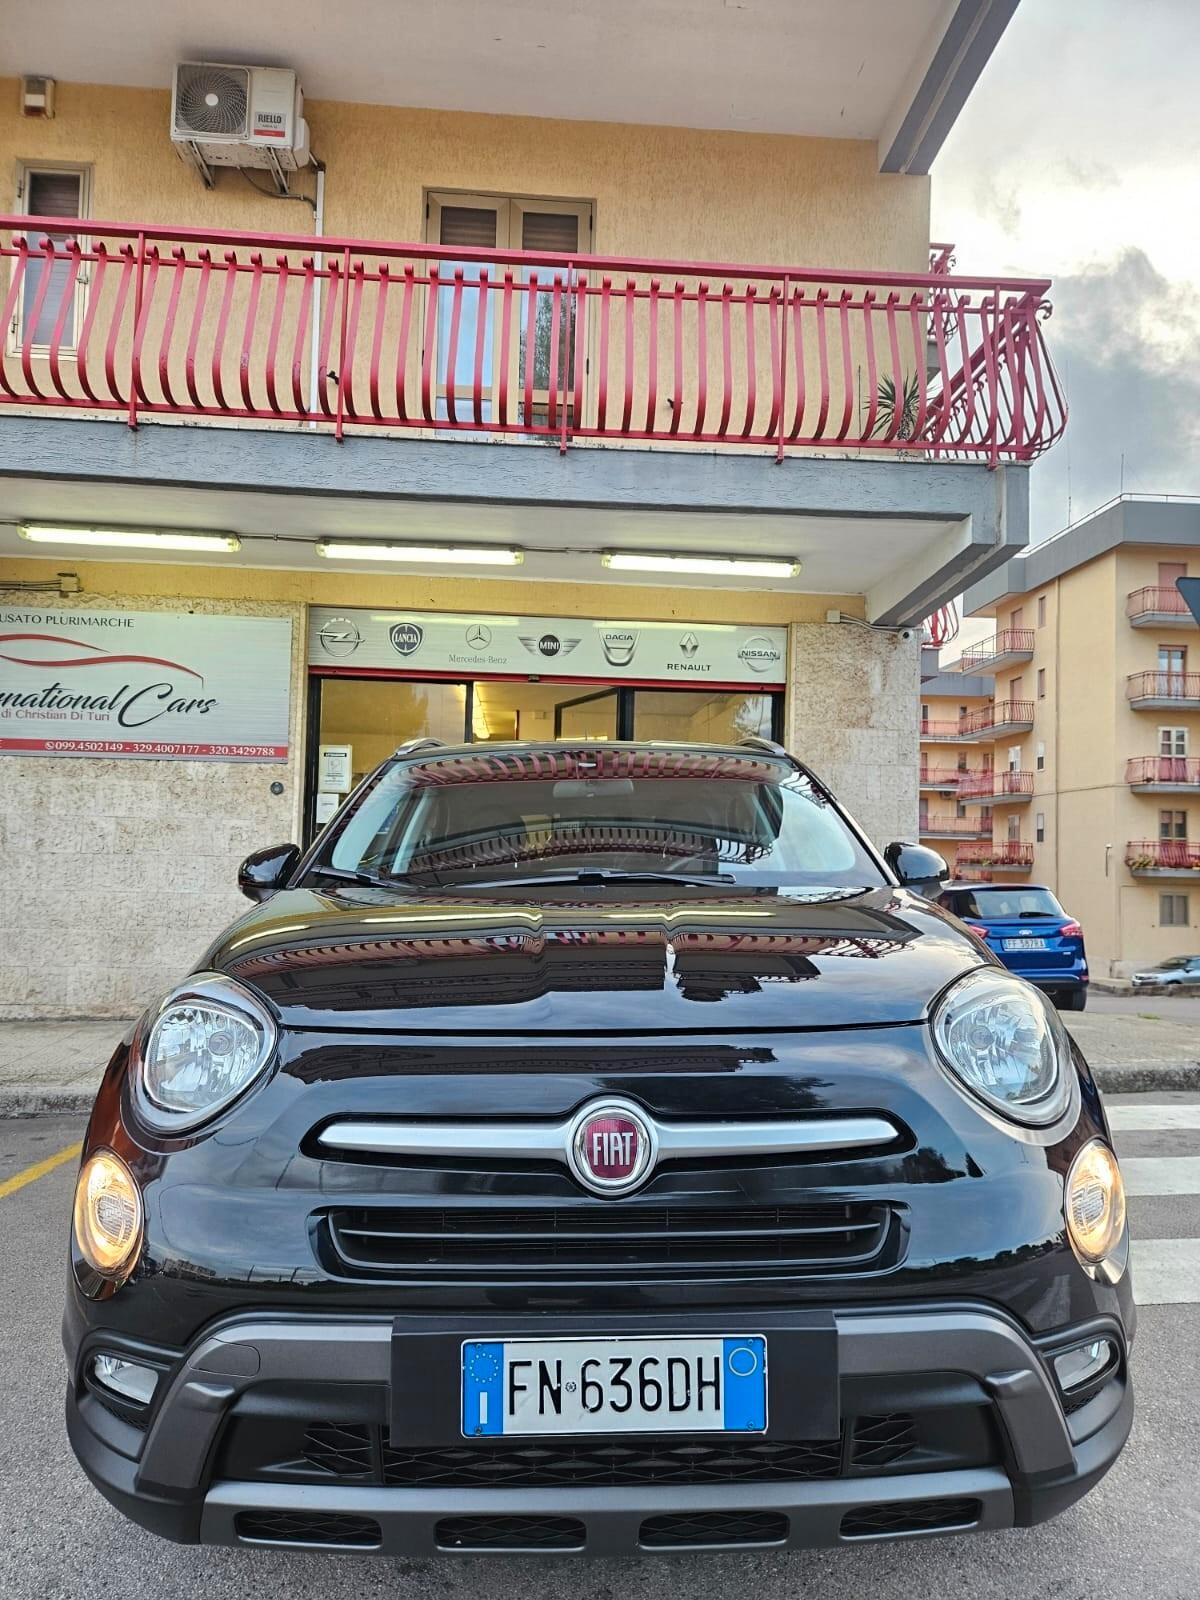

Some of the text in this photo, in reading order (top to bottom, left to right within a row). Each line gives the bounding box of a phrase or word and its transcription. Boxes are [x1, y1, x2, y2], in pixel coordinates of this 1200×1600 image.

[258, 114, 282, 124] RIELLO
[0, 613, 135, 628] USATO PLURIMARCHE
[394, 632, 418, 643] LANCIA
[605, 633, 634, 641] DACIA
[539, 641, 560, 650] MINI
[741, 649, 777, 658] NISSAN
[448, 654, 508, 665] Mercedes-Benz
[667, 663, 712, 672] RENAULT
[118, 682, 219, 728] Cars
[1, 708, 110, 721] di Christian Di Turi
[55, 741, 124, 752] 099.4502149
[132, 743, 200, 754] 329.4007177
[209, 745, 275, 756] 320.3429788
[592, 1132, 634, 1166] FIAT
[508, 1359, 562, 1416] FN
[580, 1356, 721, 1414] 636DH
